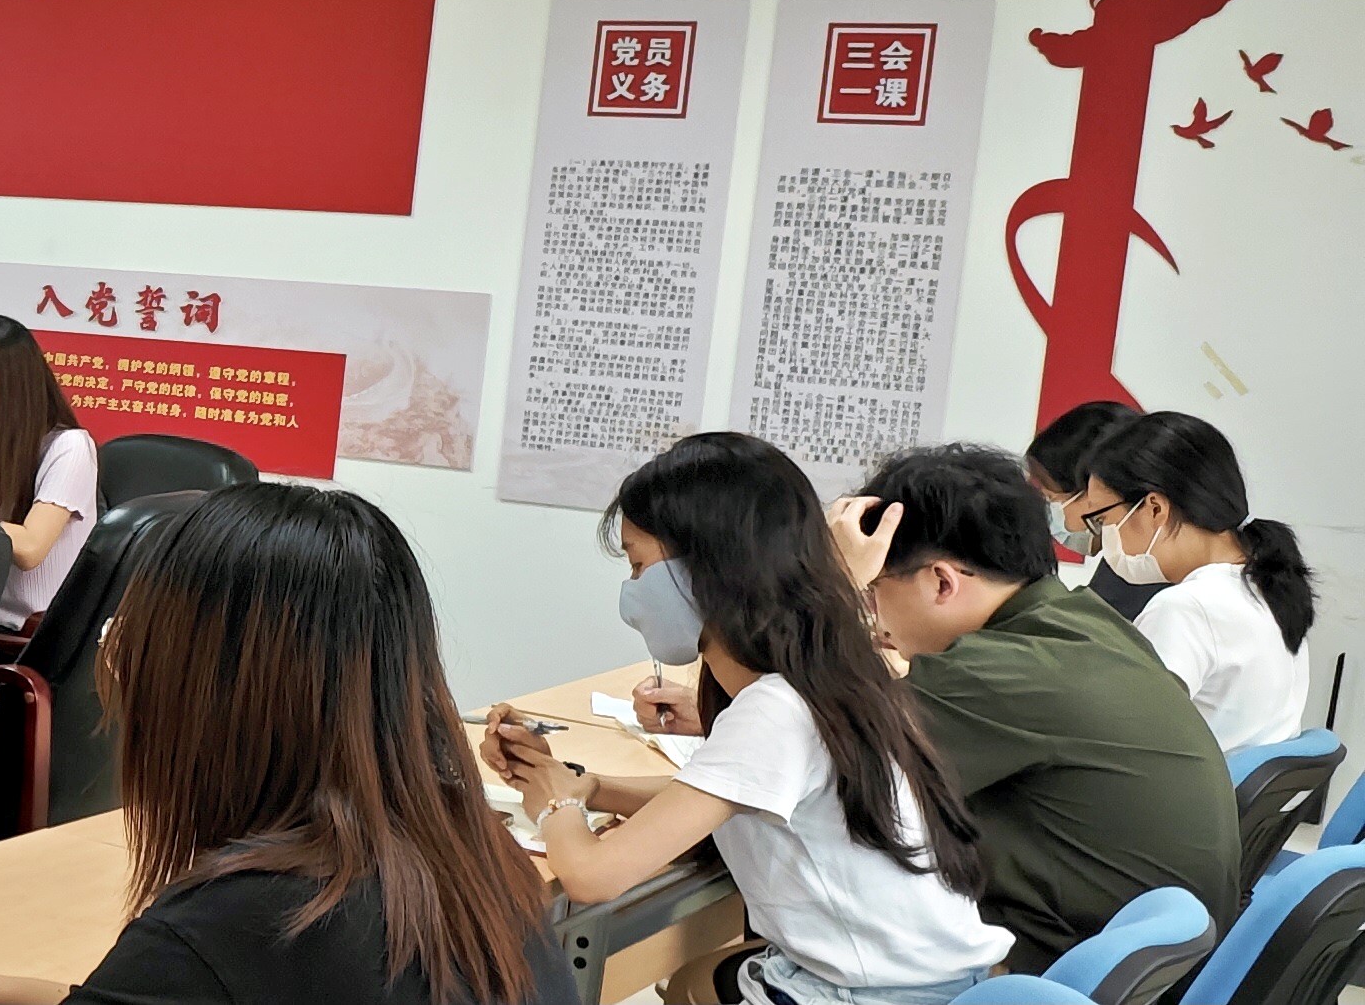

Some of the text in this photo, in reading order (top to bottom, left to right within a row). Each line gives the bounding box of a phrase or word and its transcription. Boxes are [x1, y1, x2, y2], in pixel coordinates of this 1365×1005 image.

[611, 36, 673, 67] 党员
[840, 41, 913, 72] 三会
[606, 72, 671, 103] 义务
[839, 77, 908, 108] 一课
[36, 281, 224, 334] 入党誓词
